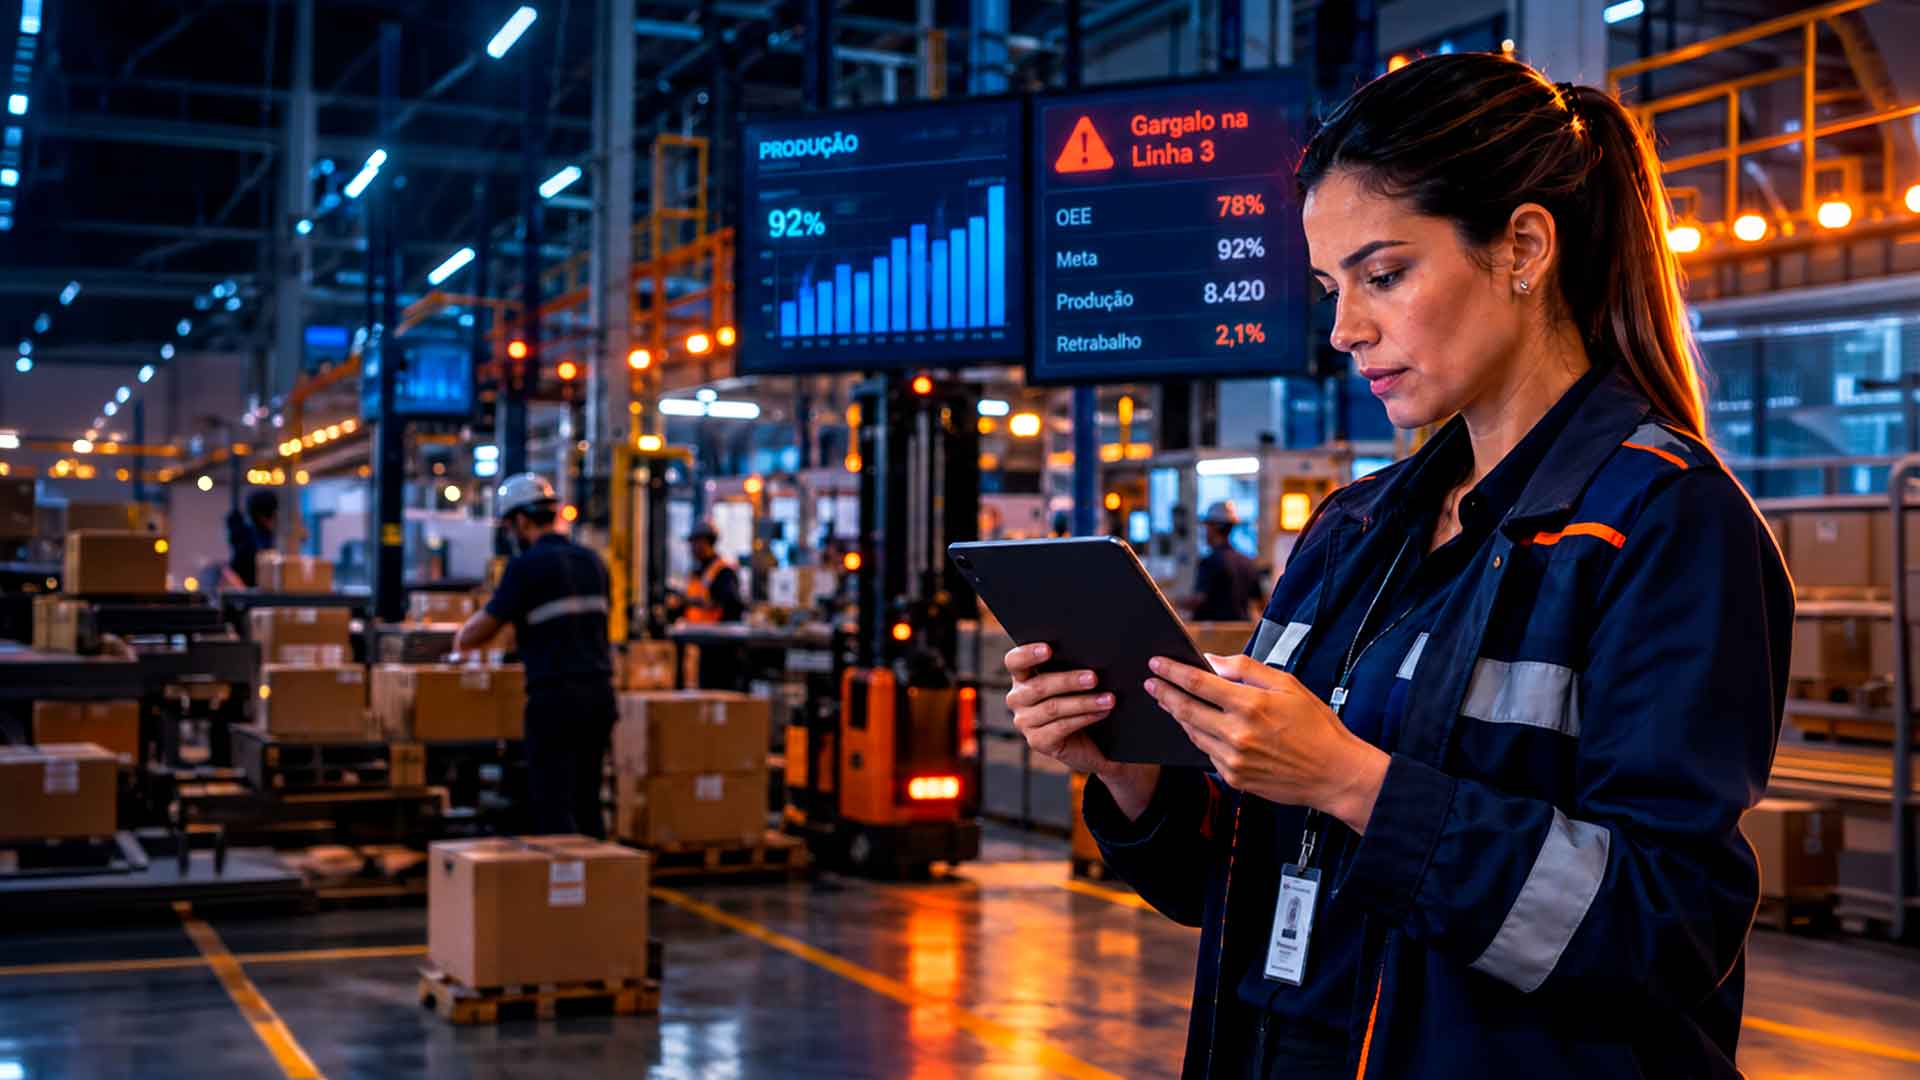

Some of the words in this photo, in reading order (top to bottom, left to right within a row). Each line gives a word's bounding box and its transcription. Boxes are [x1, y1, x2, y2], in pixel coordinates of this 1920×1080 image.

[1131, 111, 1215, 138] Gargalo
[1221, 111, 1249, 129] na
[759, 131, 859, 160] PRODUÇÃO
[1132, 143, 1193, 168] Linha
[1200, 139, 1215, 163] 3
[768, 207, 826, 238] 92%
[1055, 207, 1092, 226] OEE
[1216, 193, 1265, 218] 78%
[1056, 250, 1098, 269] Meta
[1217, 237, 1265, 260] 92%
[1056, 290, 1134, 311] Produção
[1203, 279, 1265, 304] 8.420
[1056, 333, 1142, 353] Retrabalho
[1215, 322, 1266, 348] 2,1%
